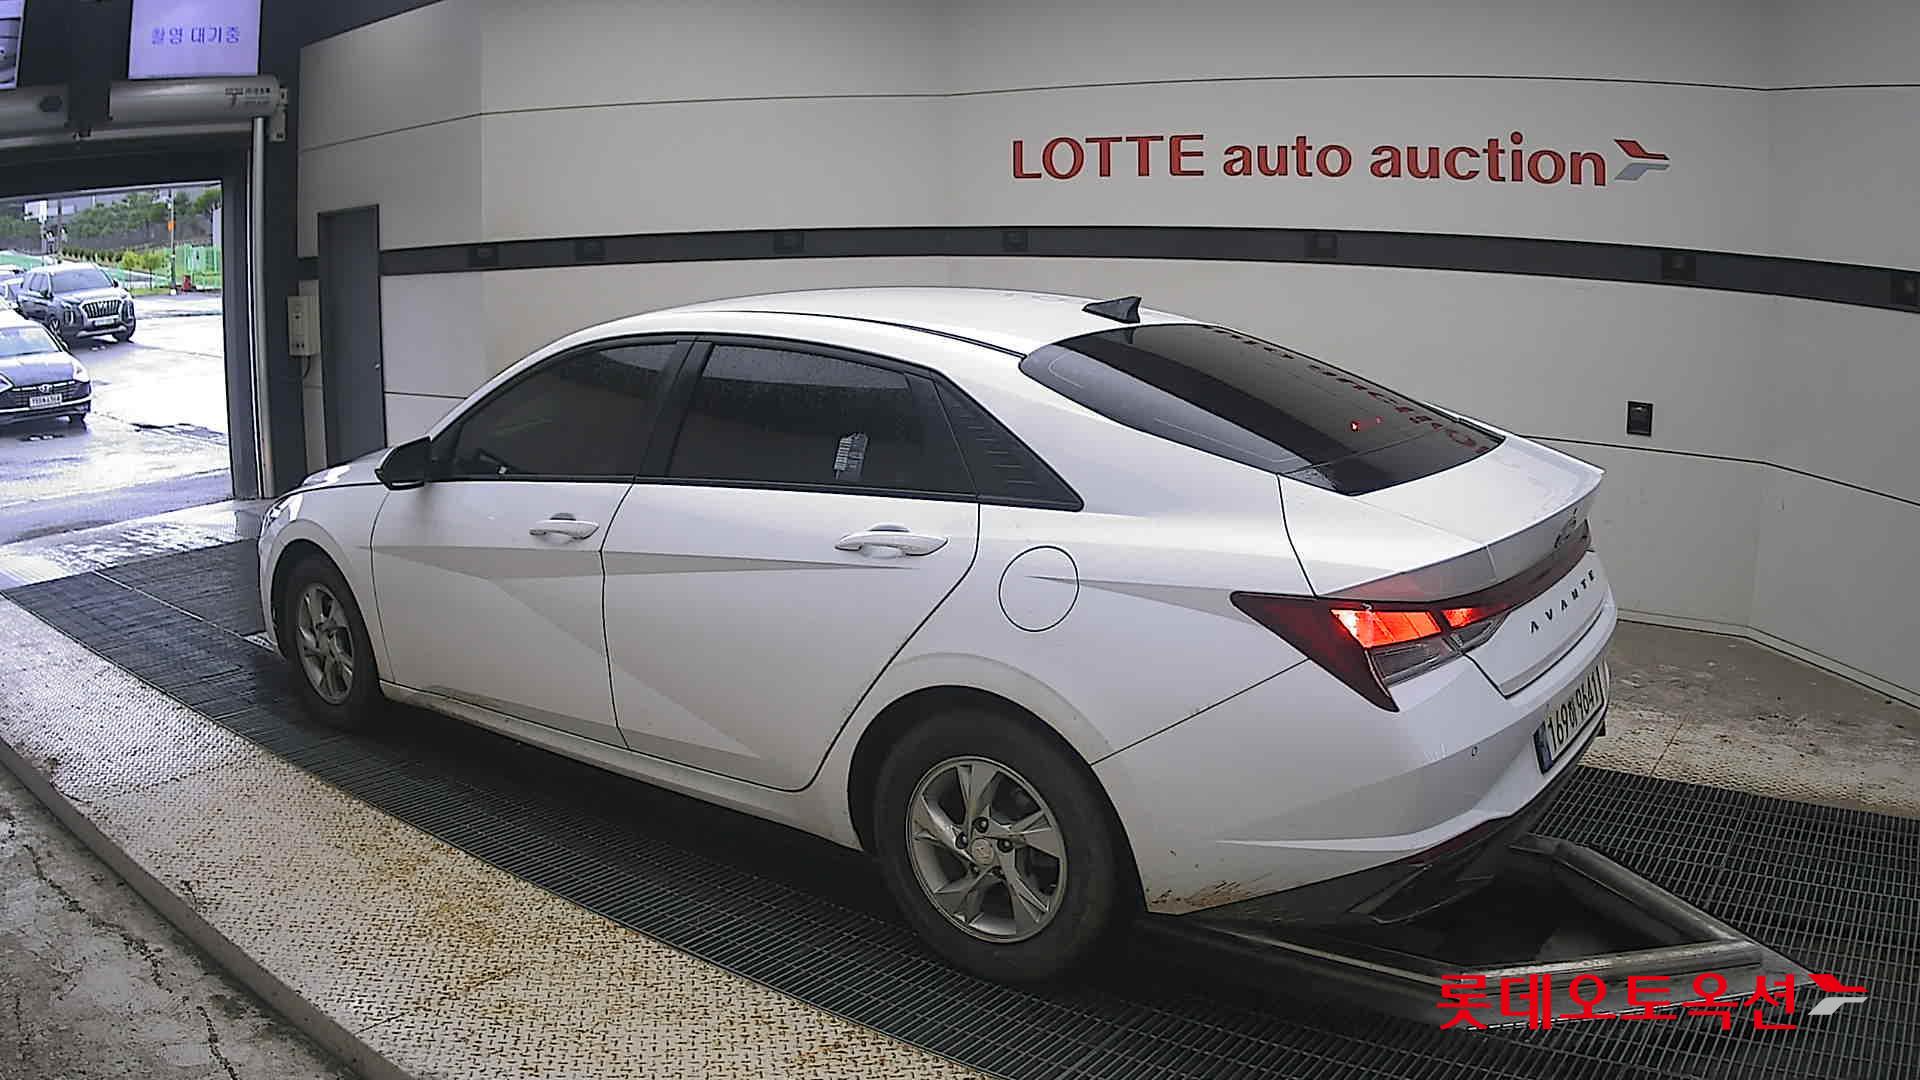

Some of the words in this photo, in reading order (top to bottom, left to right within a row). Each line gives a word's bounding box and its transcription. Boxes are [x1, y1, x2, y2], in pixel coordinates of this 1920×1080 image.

[1012, 134, 1204, 180] LOTTE
[1222, 136, 1353, 178] auto
[1369, 131, 1606, 186] auction
[1530, 569, 1594, 633] AVANTE
